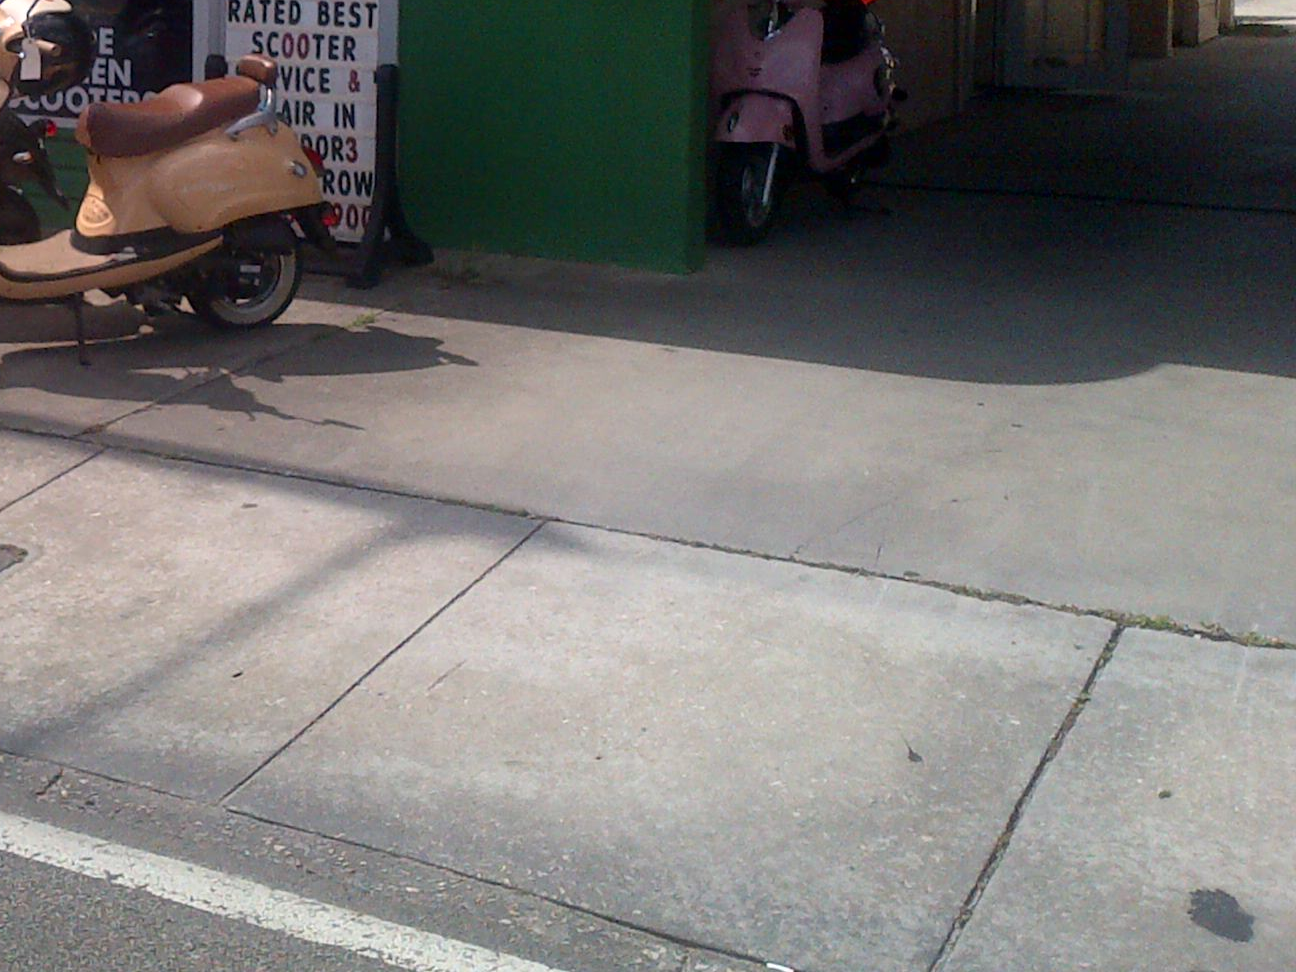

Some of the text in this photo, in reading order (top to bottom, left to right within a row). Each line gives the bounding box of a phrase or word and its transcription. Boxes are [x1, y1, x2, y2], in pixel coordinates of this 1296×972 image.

[318, 0, 378, 28] BEST
[252, 31, 356, 61] SCOOTER
[348, 69, 361, 93] &
[334, 102, 356, 129] IN
